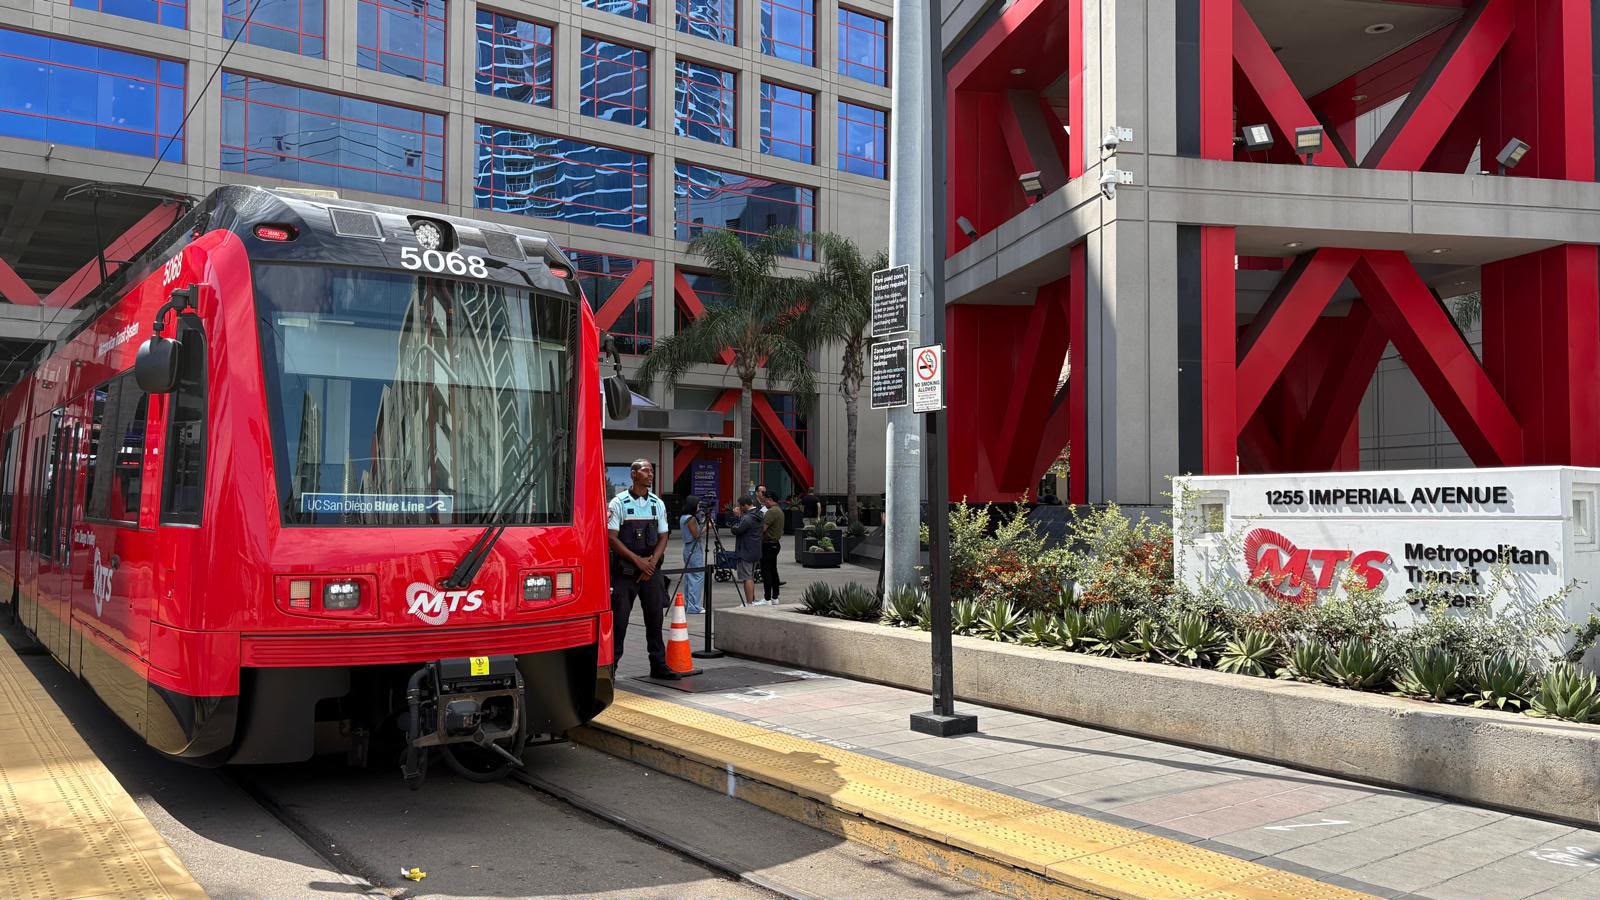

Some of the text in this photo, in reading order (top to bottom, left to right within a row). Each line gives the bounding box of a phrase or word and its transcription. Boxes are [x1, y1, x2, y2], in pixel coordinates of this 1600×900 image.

[163, 251, 183, 286] 5068
[400, 246, 488, 278] 5068
[307, 500, 425, 513] UC San Diego Blue Line
[1265, 486, 1508, 505] 1255 IMPERIAL AVENUE
[1404, 543, 1550, 567] Metropolitan
[1252, 548, 1389, 591] MTS
[1404, 565, 1479, 586] Transit
[96, 564, 113, 602] MTS
[406, 589, 485, 614] MTS
